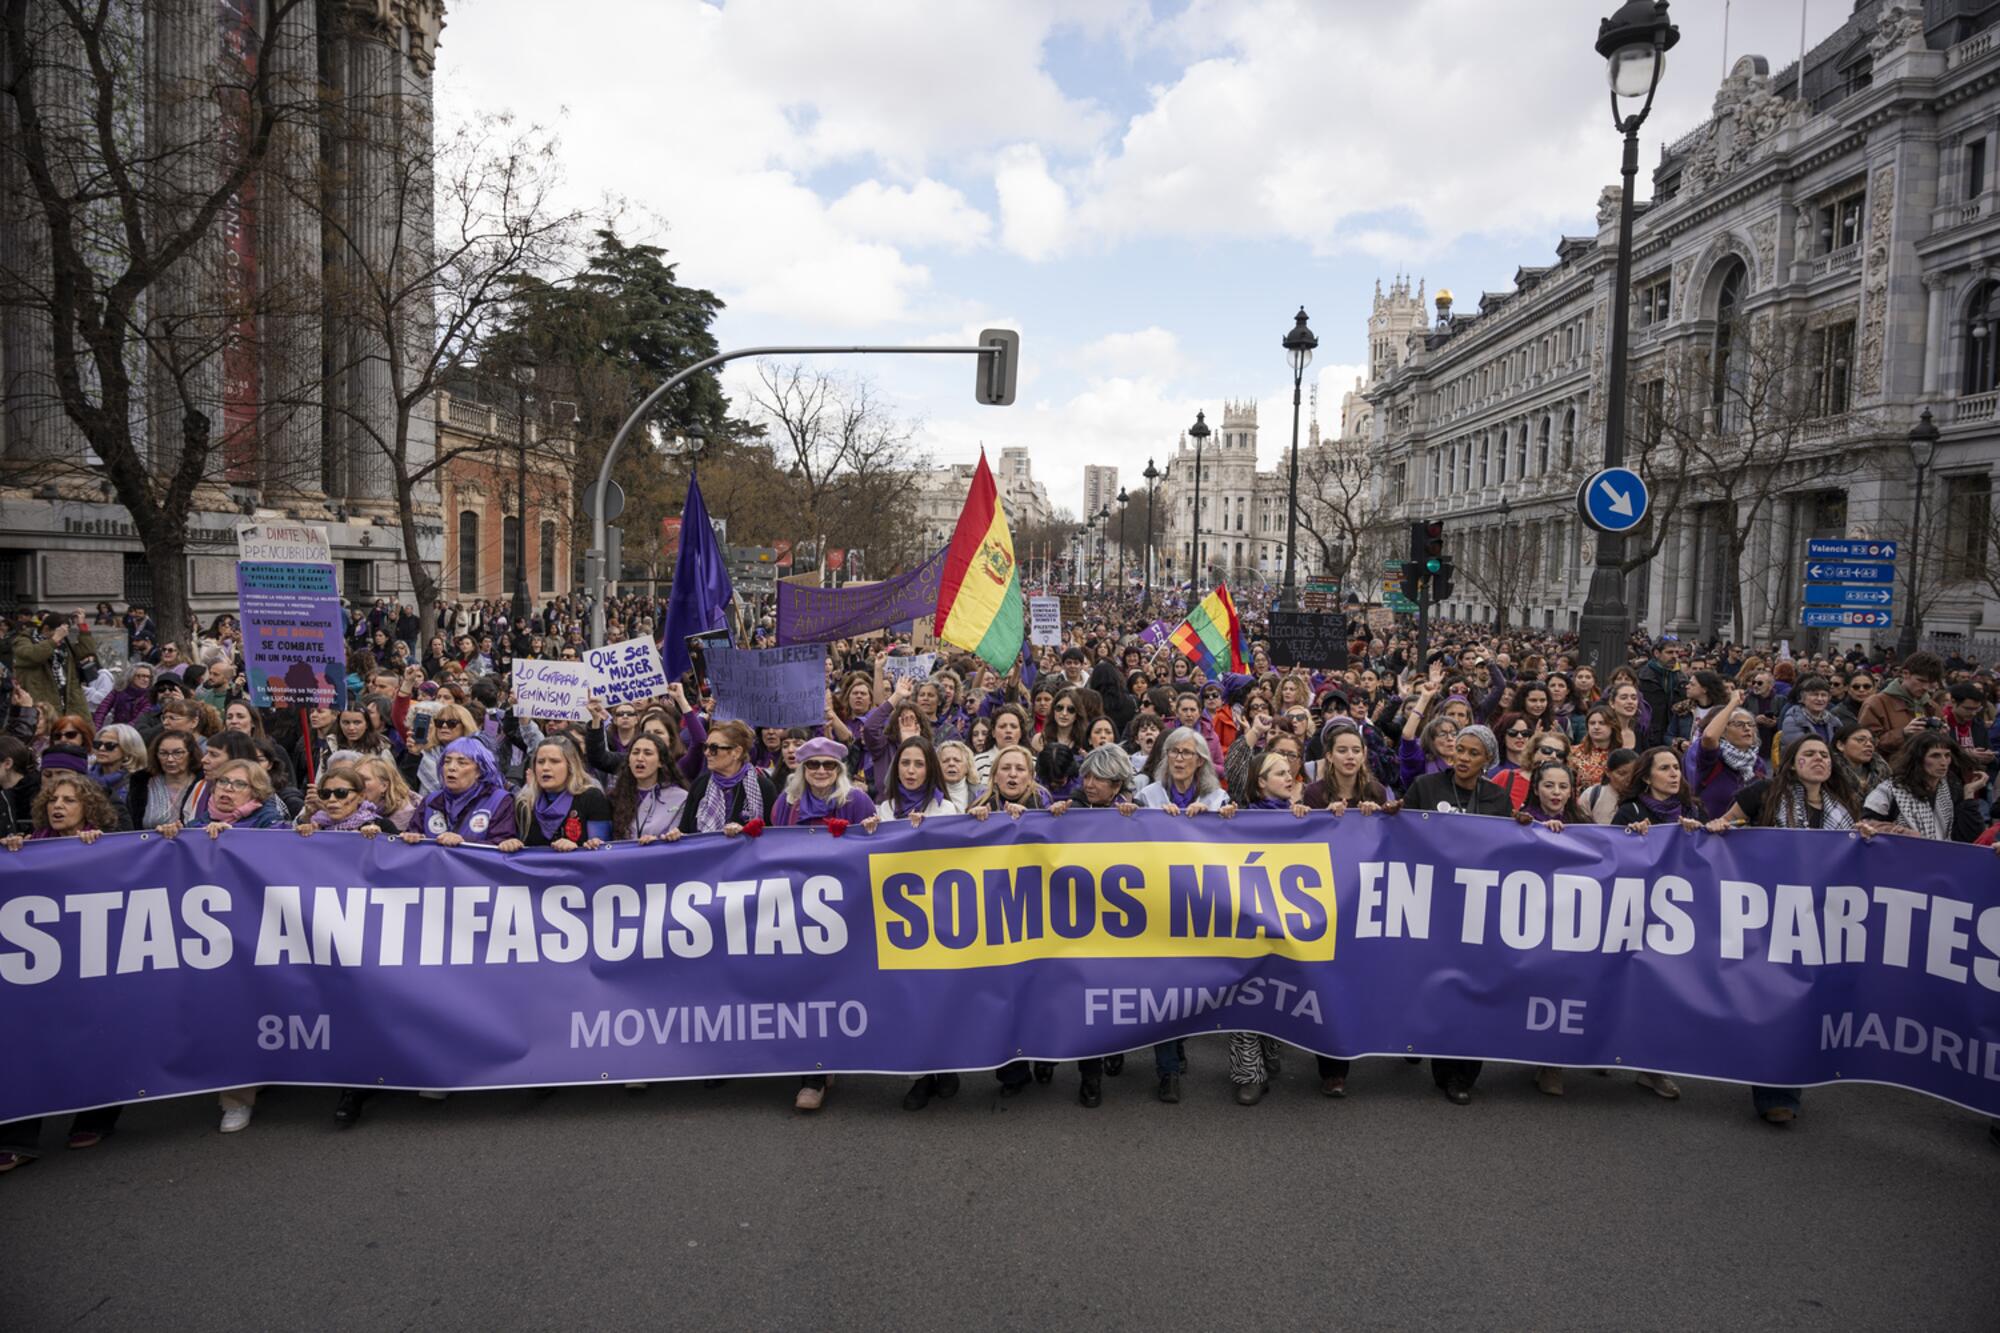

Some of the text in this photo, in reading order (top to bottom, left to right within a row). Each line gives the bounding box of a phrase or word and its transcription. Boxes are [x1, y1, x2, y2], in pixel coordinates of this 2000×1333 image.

[301, 527, 319, 544] YA
[1811, 544, 1848, 553] Valencia
[301, 620, 332, 628] MACHISTA
[262, 640, 325, 652] SE COMBATE
[1286, 639, 1311, 650] VETE
[1313, 639, 1322, 649] A
[268, 654, 279, 662] UN
[282, 655, 304, 663] PASO
[590, 644, 650, 674] QUE SER
[515, 660, 534, 680] LO
[609, 658, 653, 680] MUJER
[593, 673, 665, 697] NO NOS CUESTE
[605, 687, 653, 705] LA VIDA
[0, 884, 234, 985] STAS
[254, 875, 849, 967] ANTIFASCISTAS
[882, 863, 1148, 950] SOMOS
[1168, 851, 1328, 942] MÁS
[1355, 861, 1434, 940] EN
[1454, 867, 1696, 955] TODAS
[257, 1014, 331, 1050] 8M
[570, 1000, 869, 1048] MOVIMIENTO
[1084, 976, 1324, 1026] FEMINISTA
[1526, 996, 1587, 1035] DE
